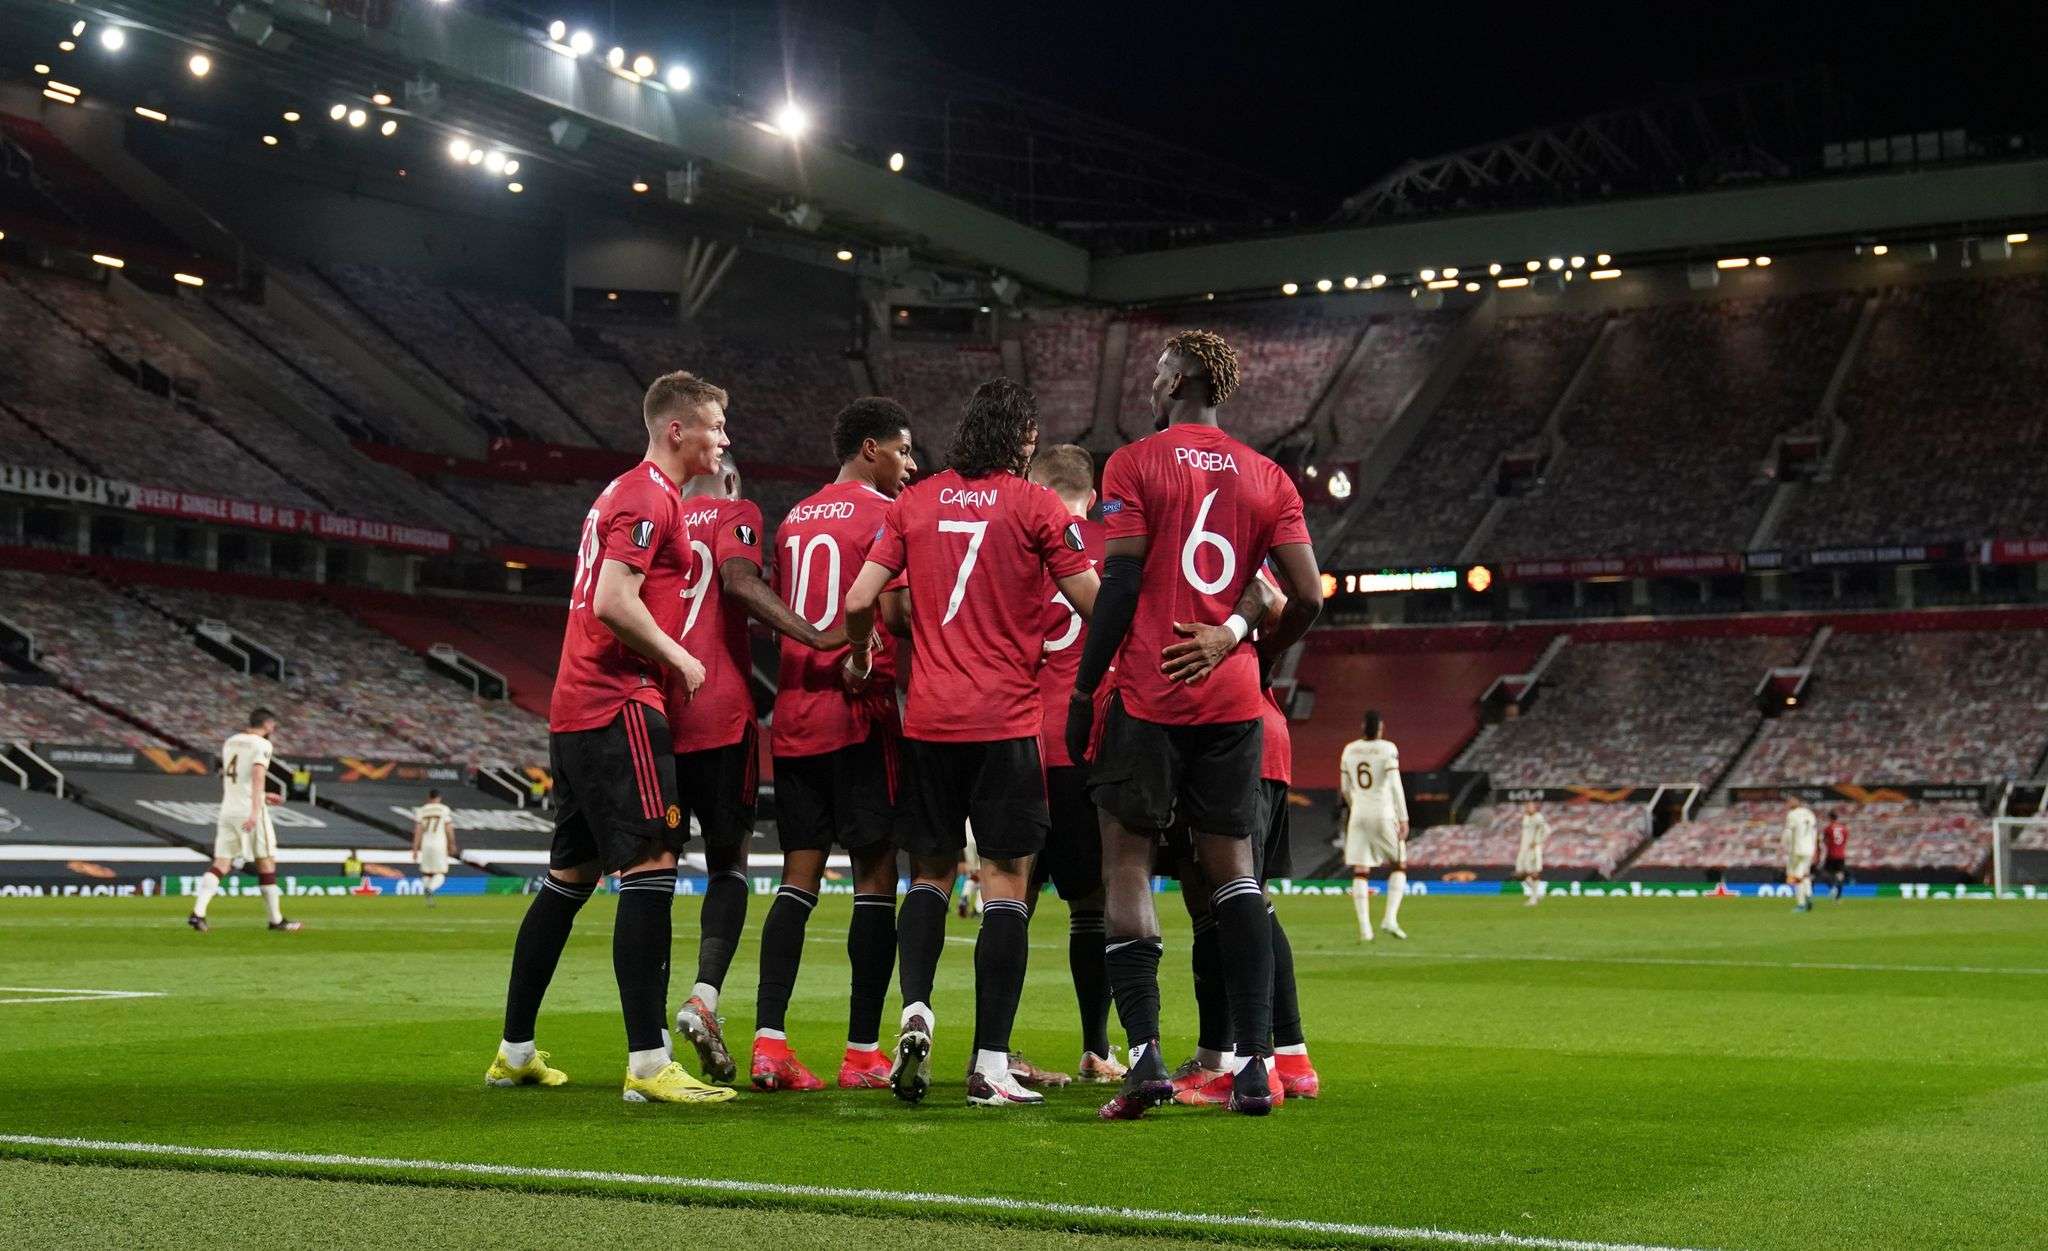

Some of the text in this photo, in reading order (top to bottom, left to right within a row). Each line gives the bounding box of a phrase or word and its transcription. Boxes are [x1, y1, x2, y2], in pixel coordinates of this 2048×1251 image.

[1175, 447, 1239, 475] POGBA
[939, 488, 998, 509] CAVANI
[786, 502, 855, 524] RASHFORD
[1181, 487, 1236, 595] 6
[785, 533, 841, 632] 10
[938, 520, 989, 627] 7
[226, 754, 238, 783] 4
[1357, 761, 1373, 789] 6
